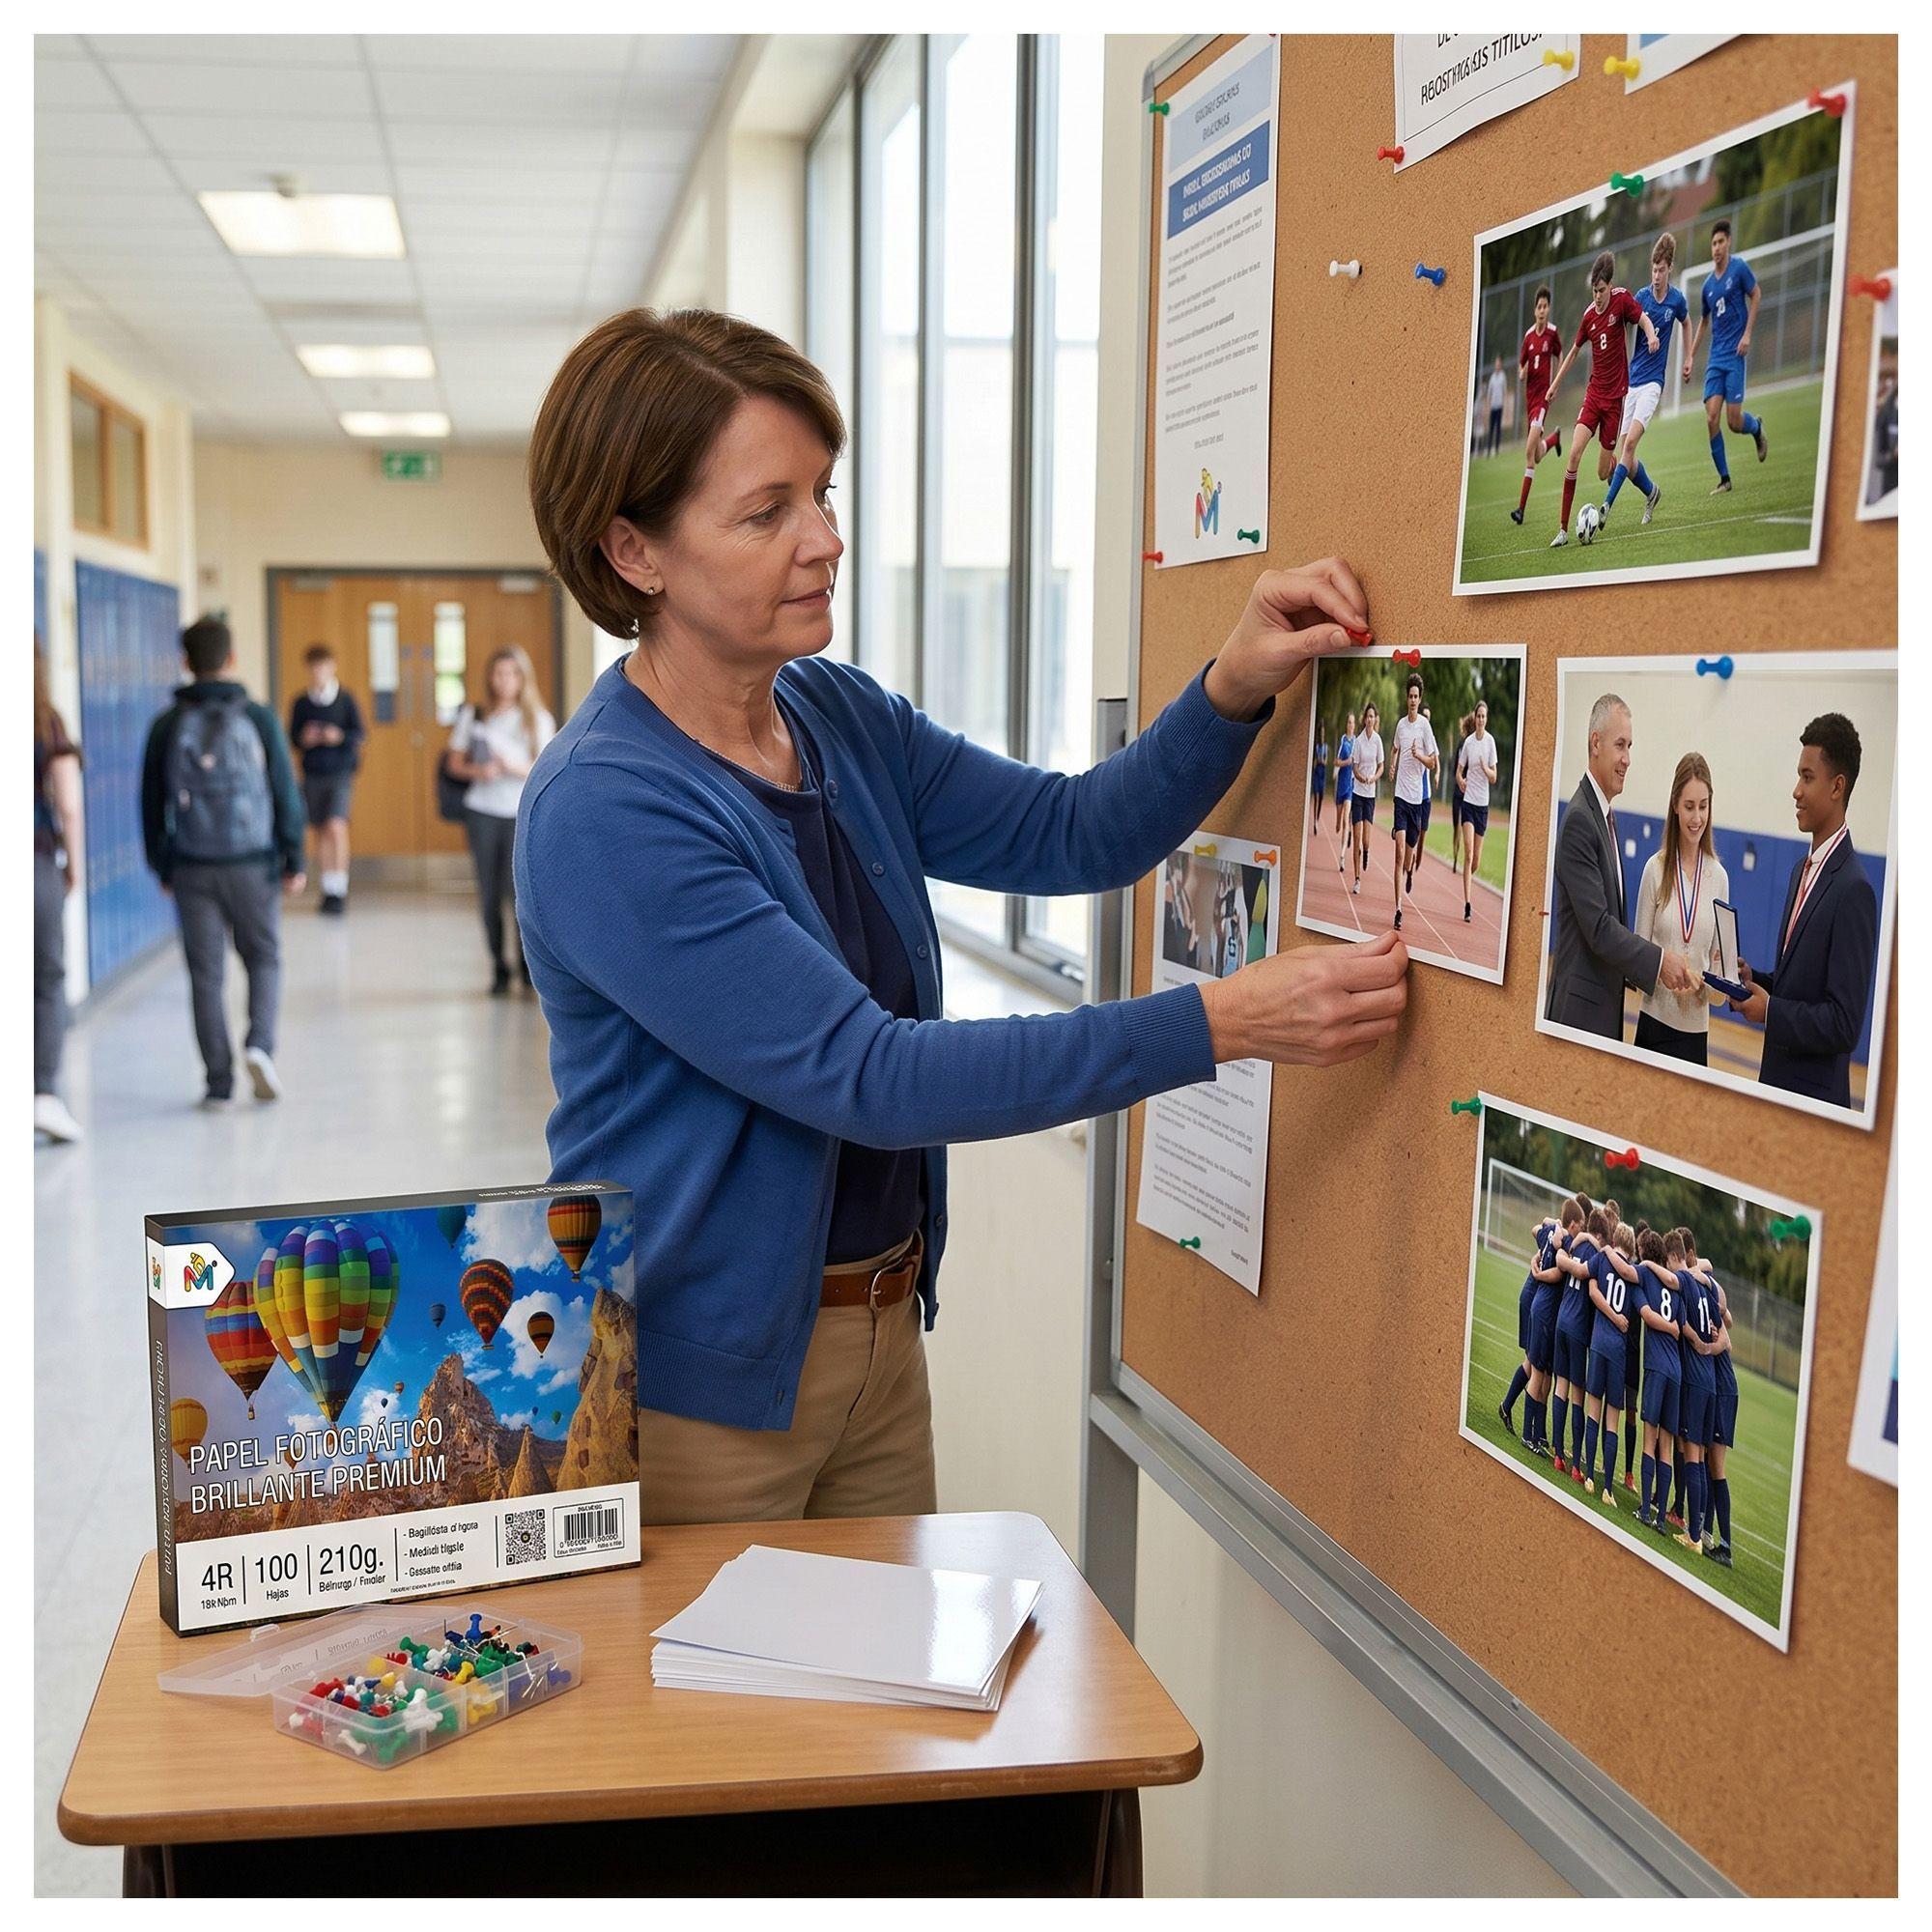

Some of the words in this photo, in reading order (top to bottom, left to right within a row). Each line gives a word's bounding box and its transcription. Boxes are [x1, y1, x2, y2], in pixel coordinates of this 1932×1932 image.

[1605, 1272, 1626, 1314] 10
[1661, 1288, 1672, 1321] 8
[1697, 1296, 1712, 1335] 11
[189, 1437, 268, 1474] PAPEL
[275, 1417, 443, 1463] FOTOGRÁFICO
[190, 1469, 326, 1515] BRILLANTE
[332, 1454, 446, 1495] PREMIUM
[201, 1562, 234, 1592] 4R
[255, 1552, 298, 1584] 100
[319, 1545, 384, 1576] 210g.
